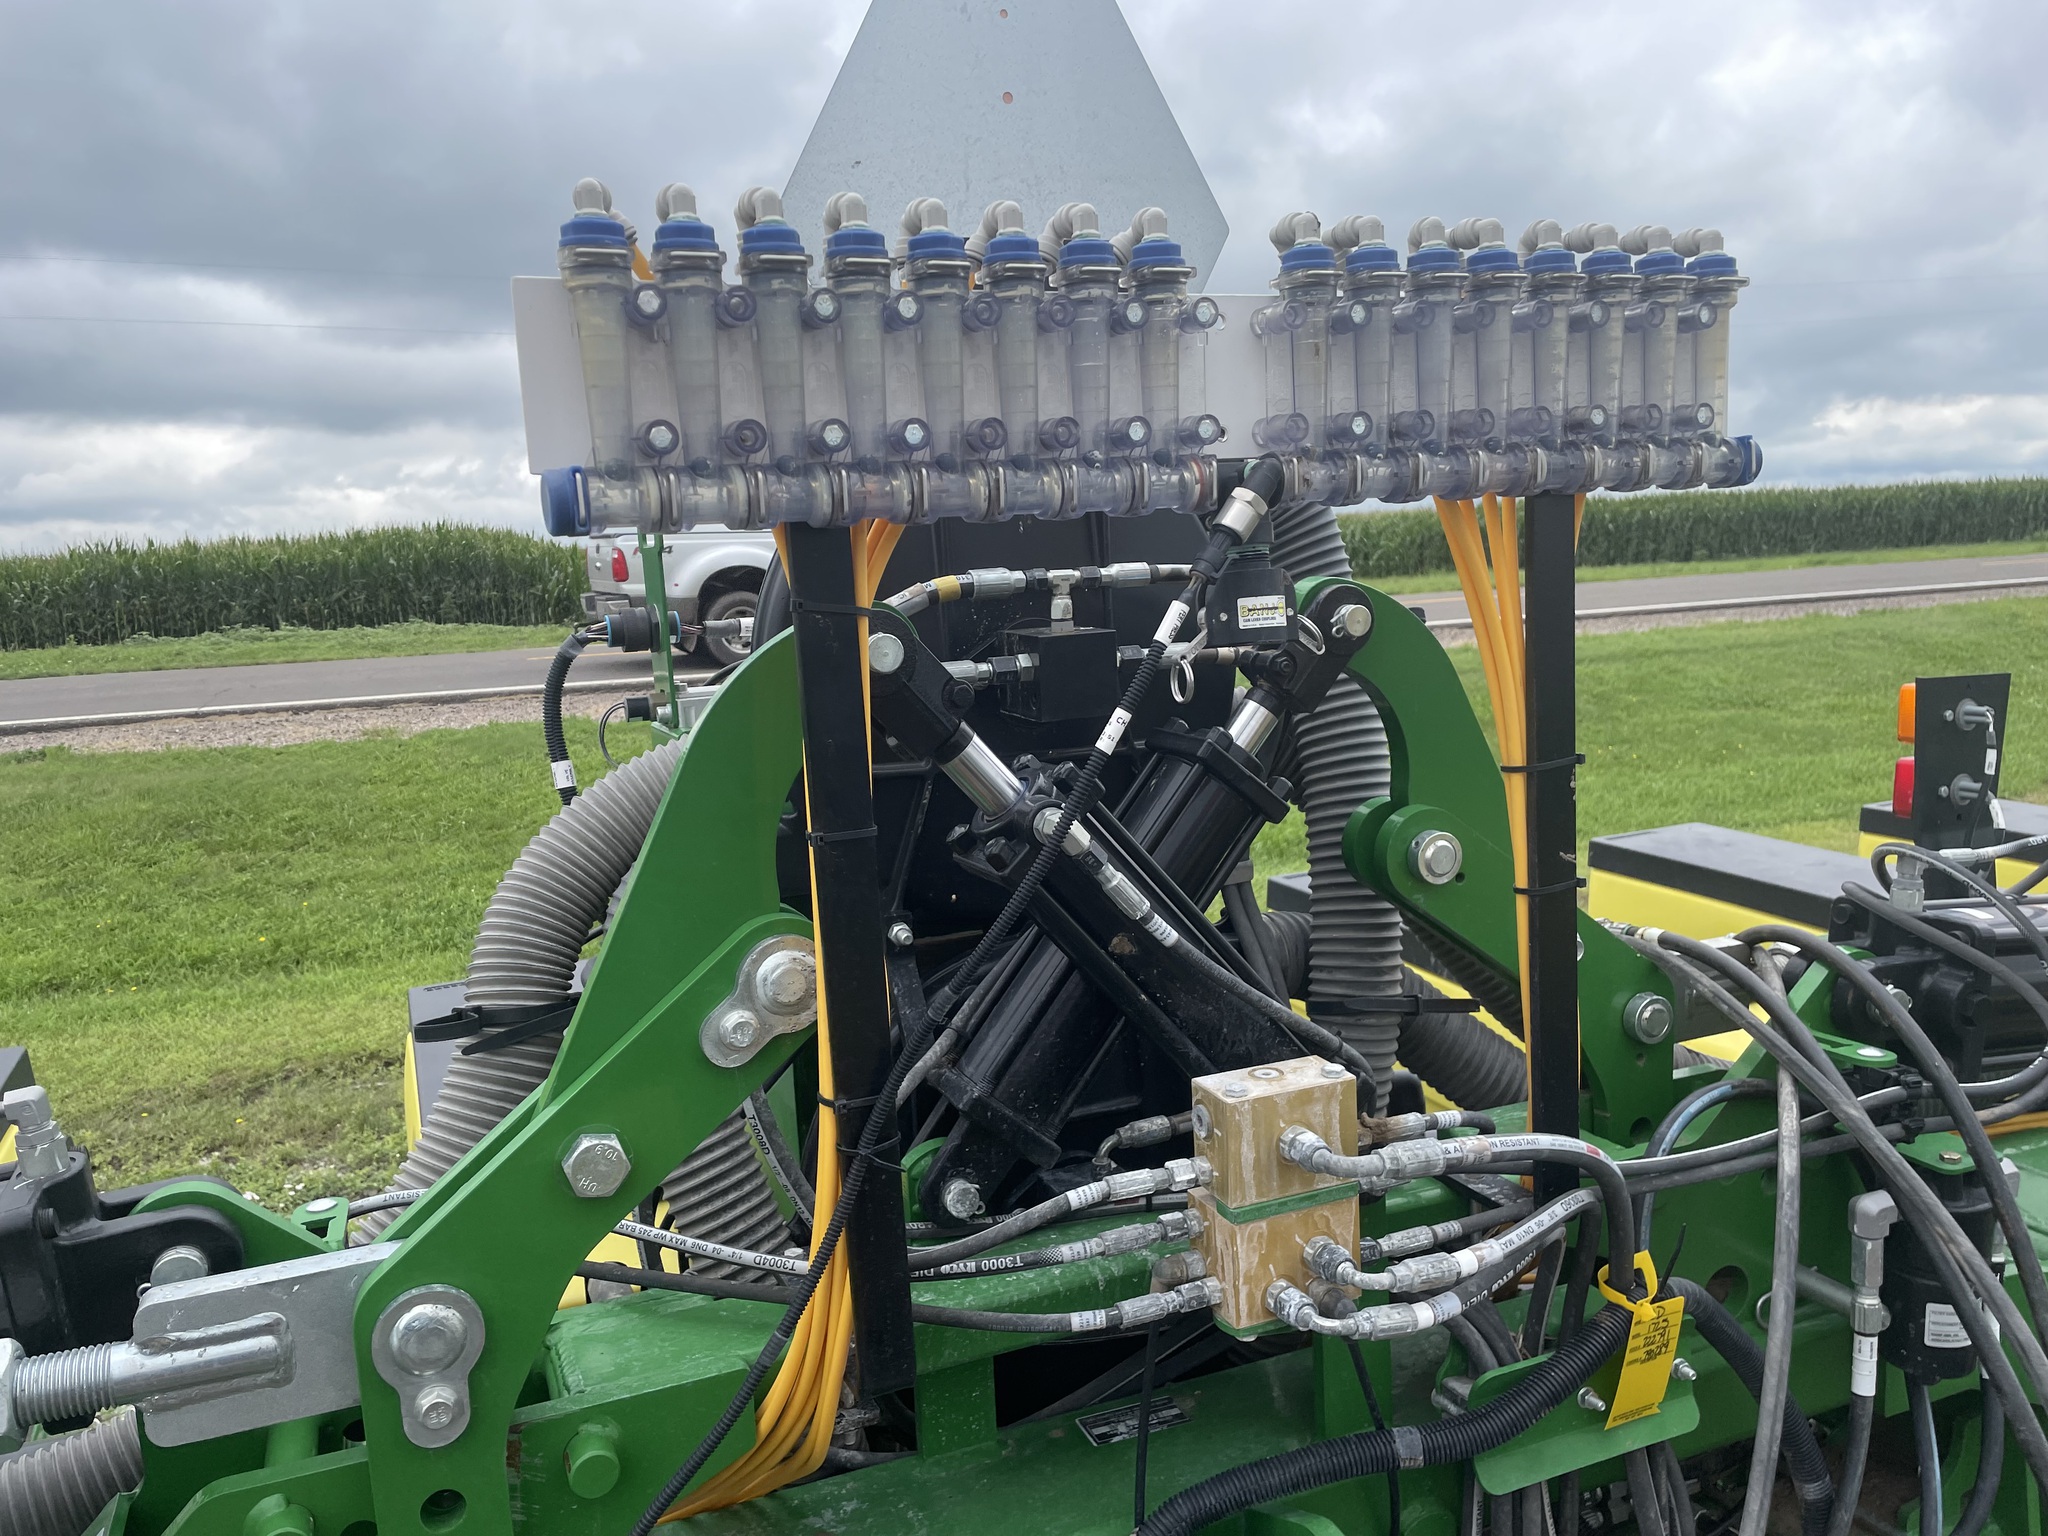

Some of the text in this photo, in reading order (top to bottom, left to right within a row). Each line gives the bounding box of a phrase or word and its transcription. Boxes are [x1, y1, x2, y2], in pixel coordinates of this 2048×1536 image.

[1168, 609, 1187, 640] FERT PRESS
[748, 1114, 771, 1155] T3008D
[1499, 1137, 1541, 1148] RESISTANT
[594, 1145, 618, 1160] 10.9
[618, 1221, 797, 1272] T3004D 1/4" -04 DN6 MAX WP 245 BAR
[940, 1261, 976, 1275] RYCO
[981, 1255, 1024, 1272] T3000
